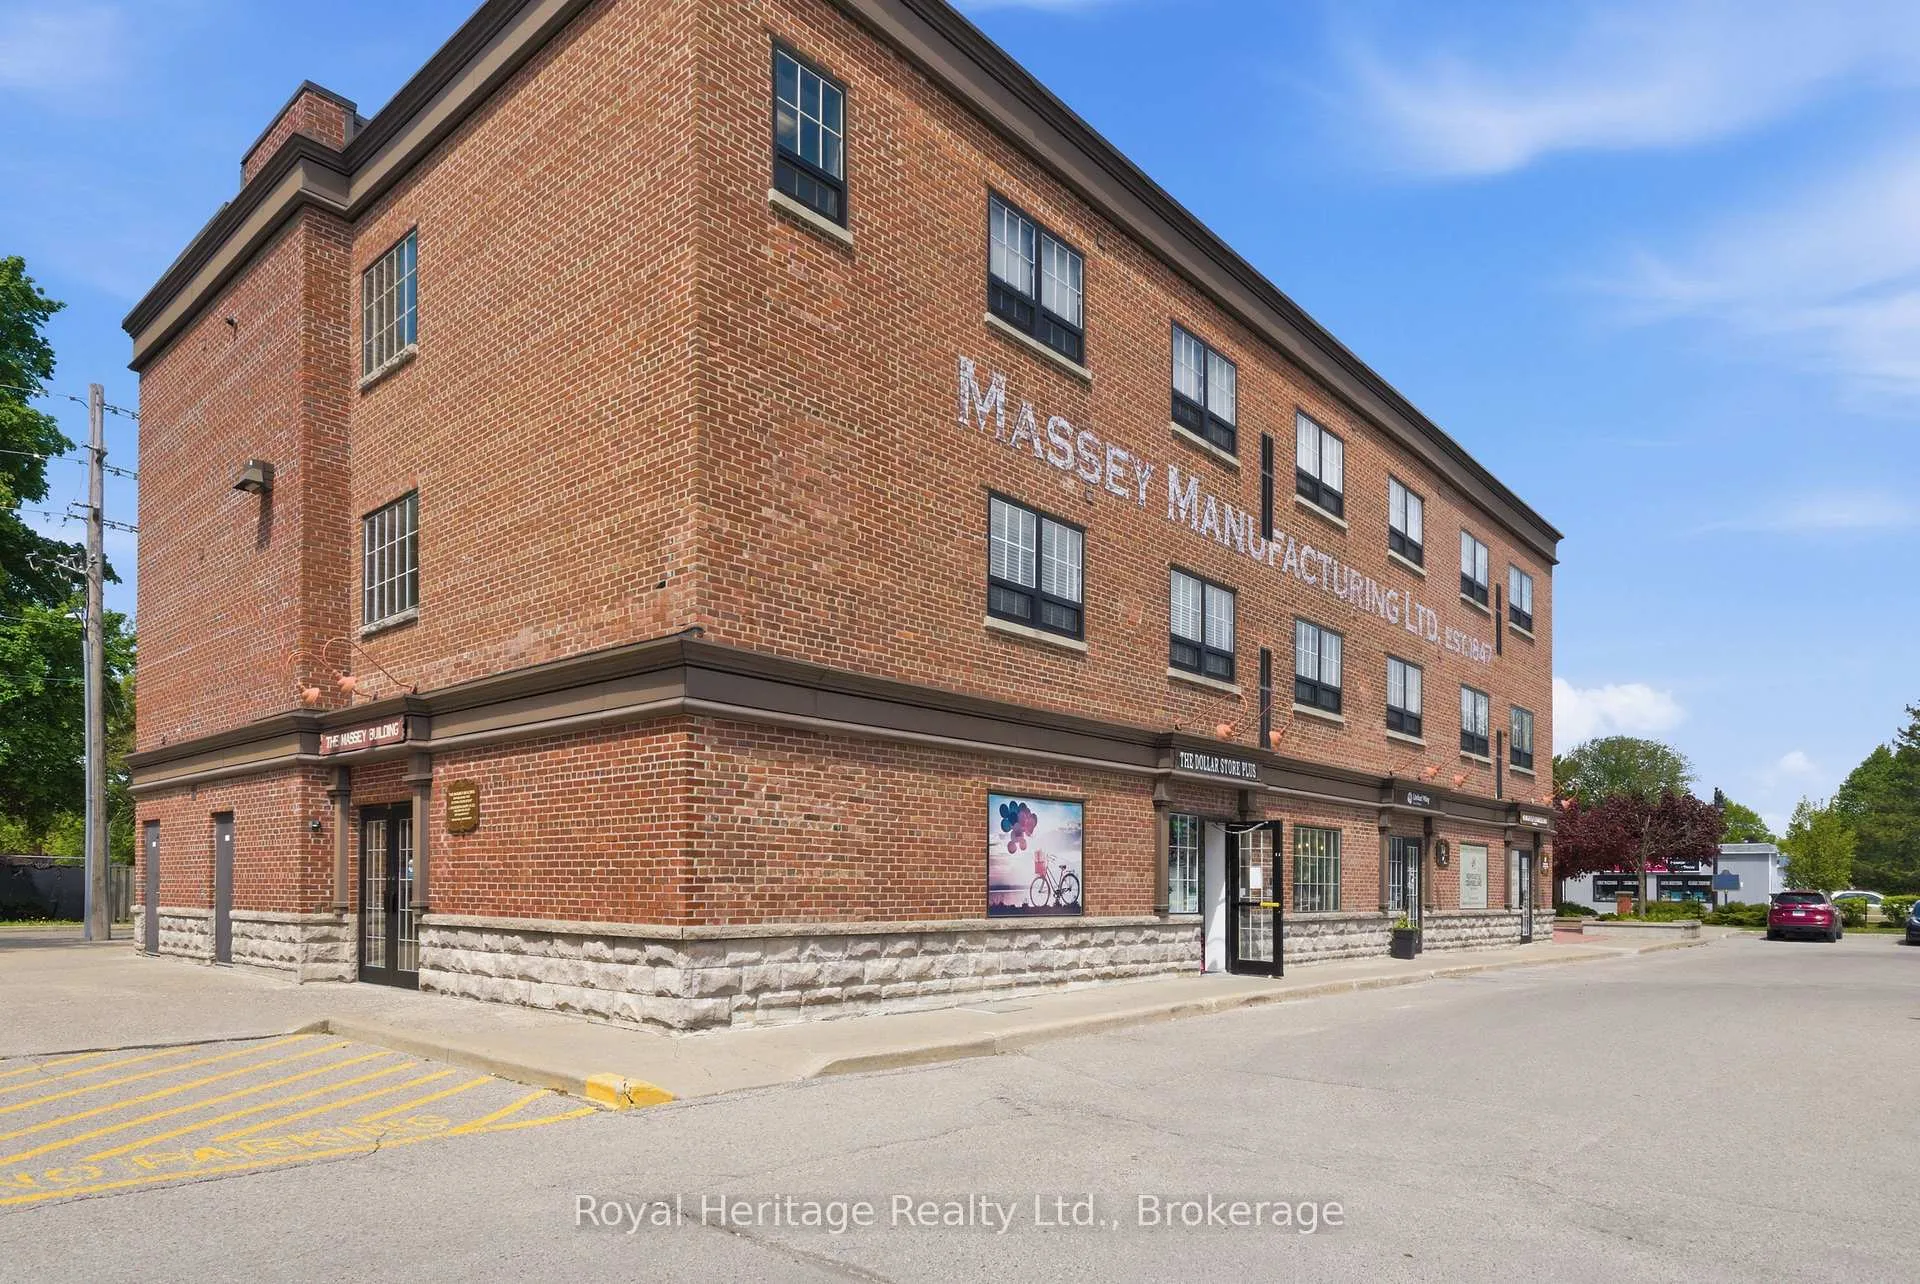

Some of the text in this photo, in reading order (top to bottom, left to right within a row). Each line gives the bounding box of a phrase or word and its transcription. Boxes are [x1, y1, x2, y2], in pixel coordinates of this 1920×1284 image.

[958, 355, 1154, 507] MASSEY
[1167, 464, 1399, 625] MANUFACTURING
[326, 722, 399, 748] THE MASSEY BUILDING
[1180, 751, 1257, 778] THE DOLLAR STORE PLUS
